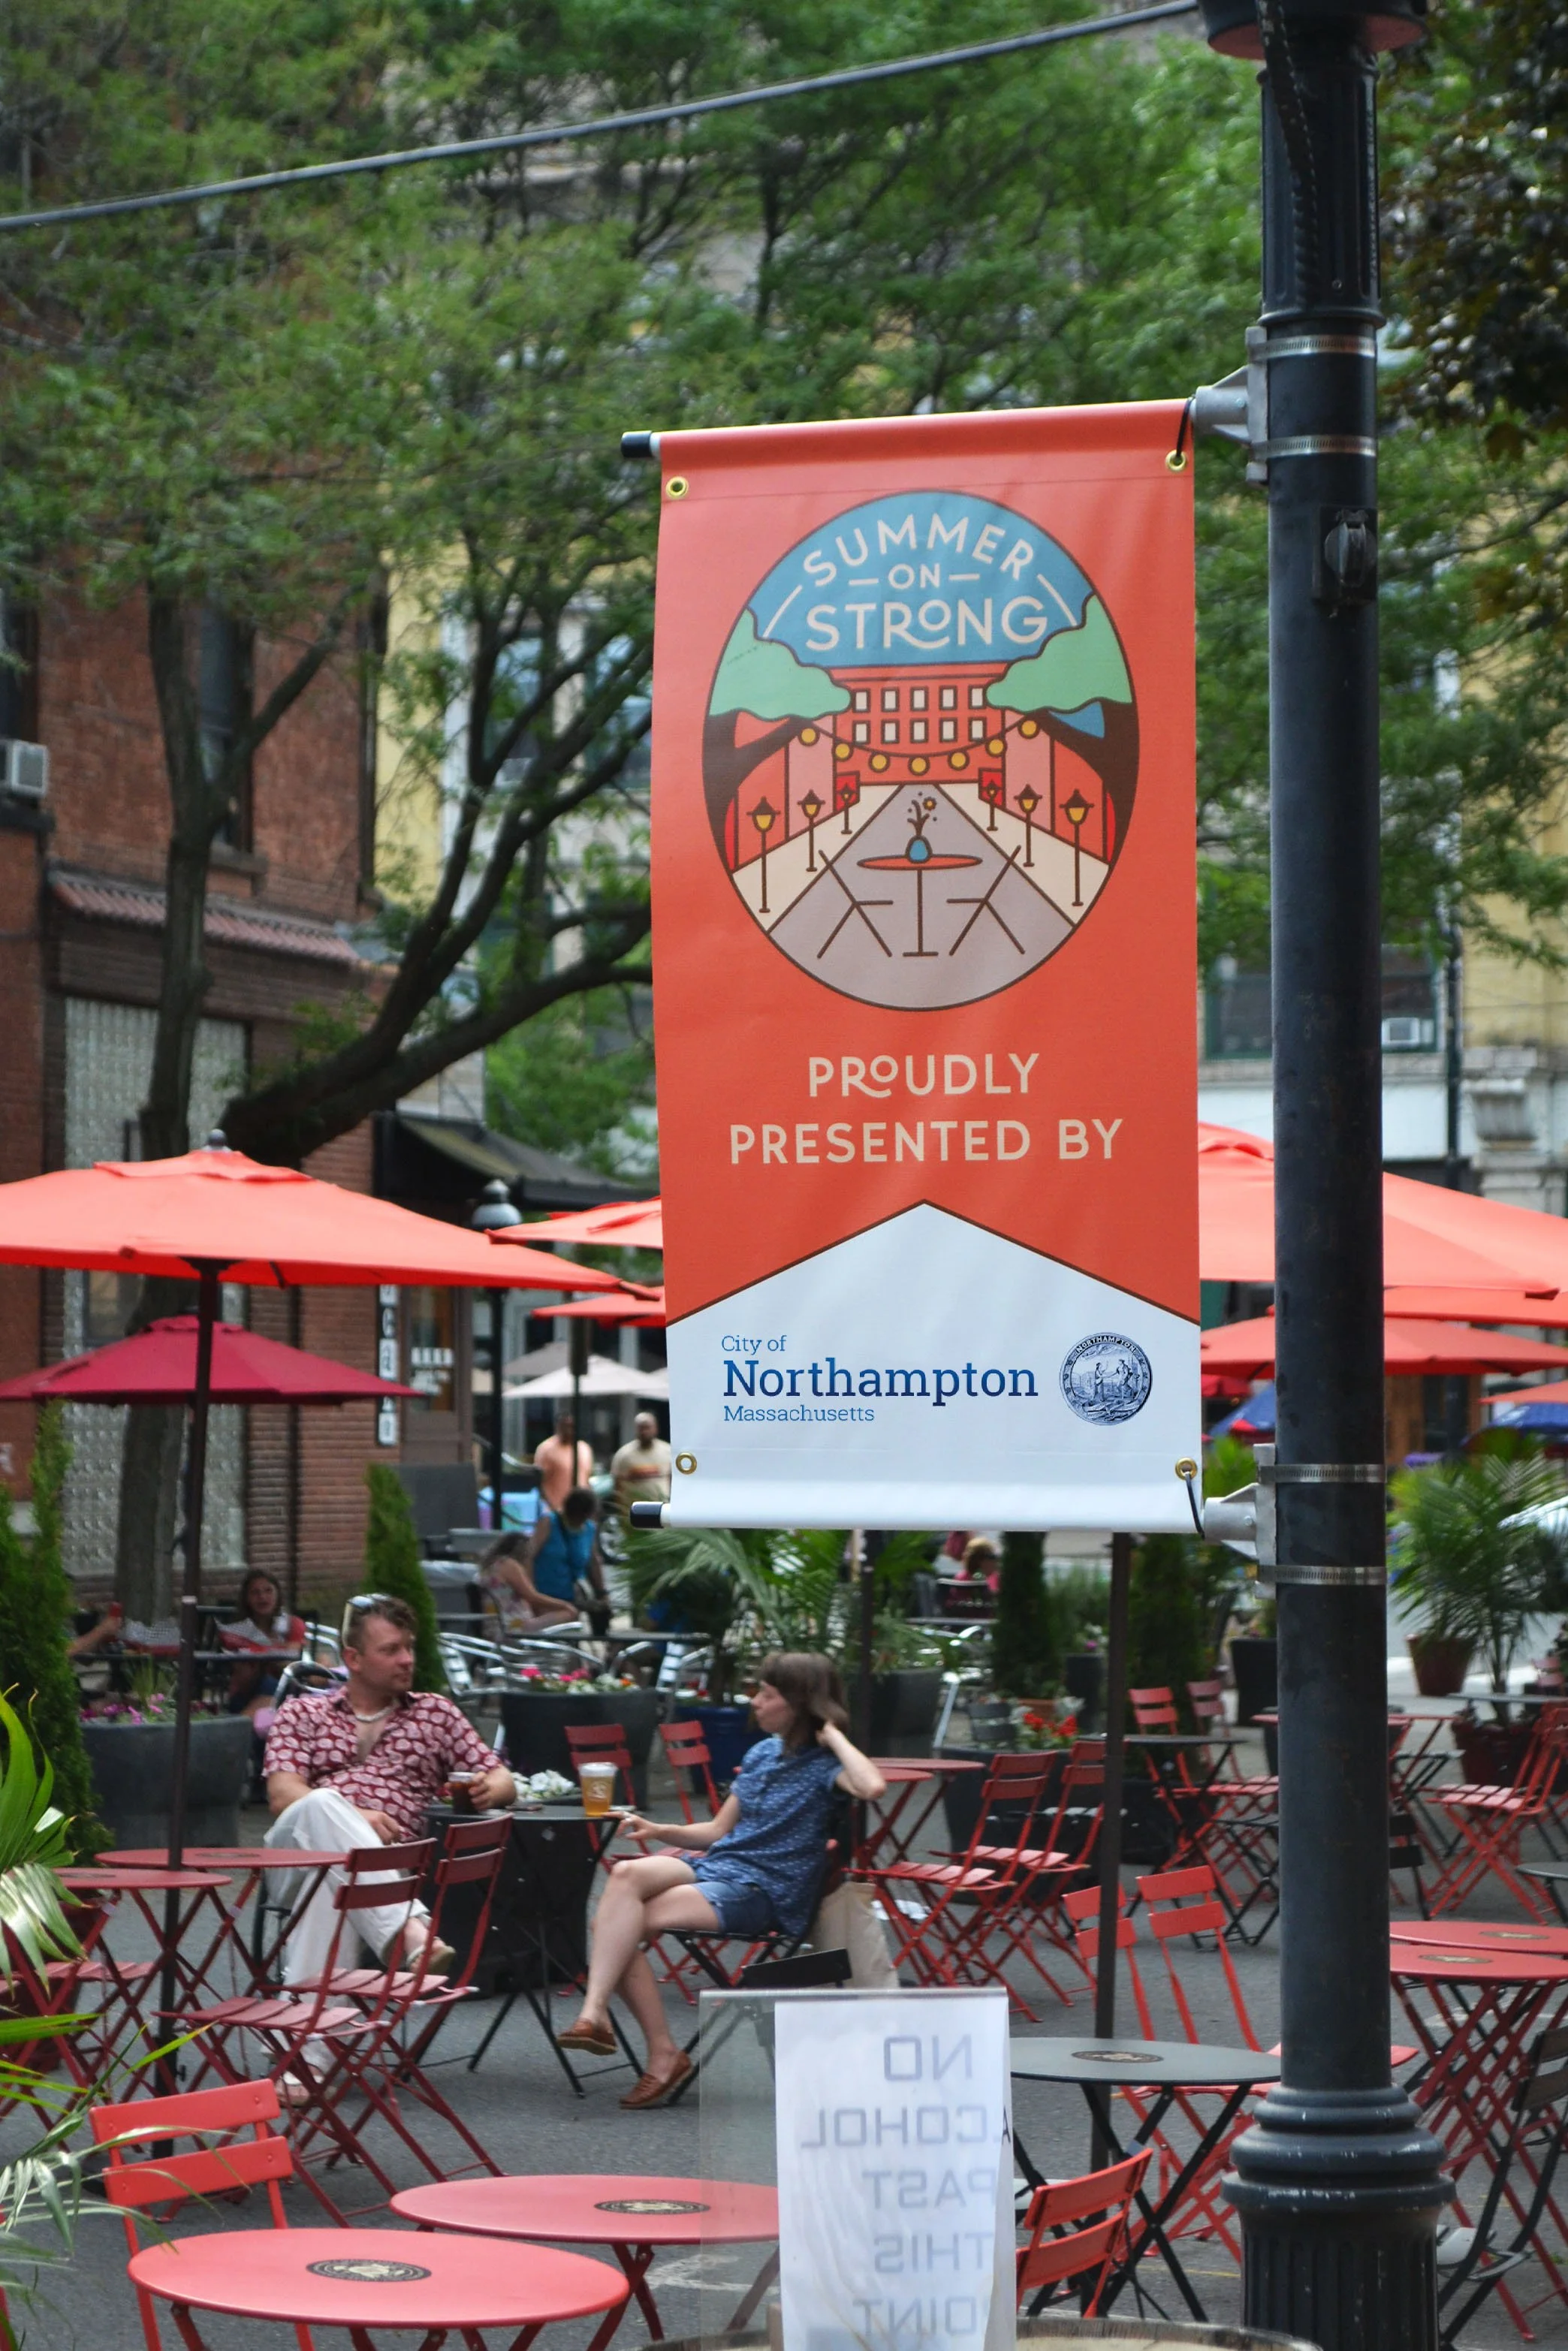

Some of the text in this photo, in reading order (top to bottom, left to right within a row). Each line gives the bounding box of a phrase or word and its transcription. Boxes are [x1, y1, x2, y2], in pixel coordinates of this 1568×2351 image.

[803, 512, 1034, 587] SUMMER
[888, 563, 941, 589] ON
[805, 595, 1048, 651] STRONG
[808, 1053, 1040, 1098] PROUDLY
[729, 1119, 1123, 1165] PRESENTED BY
[721, 1334, 788, 1355] City of
[1075, 1335, 1138, 1355] NORTHAMPTON
[722, 1357, 1039, 1406] Northampton
[722, 1405, 876, 1421] Massachusetts
